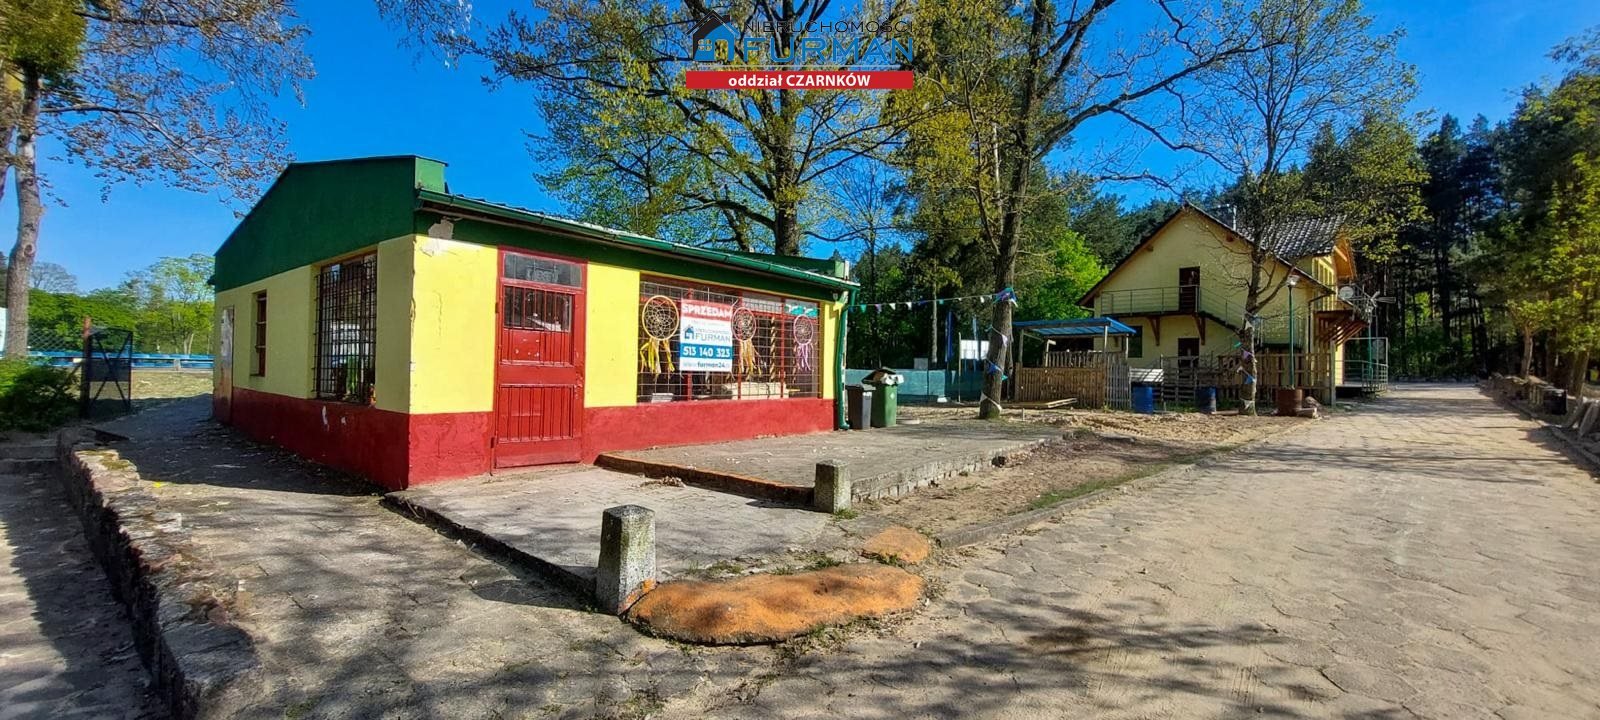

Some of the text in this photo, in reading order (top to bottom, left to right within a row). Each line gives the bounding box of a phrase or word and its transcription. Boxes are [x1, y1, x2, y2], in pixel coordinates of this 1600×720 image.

[682, 303, 732, 319] SPRZEDAM
[695, 332, 731, 343] FURMAN
[683, 346, 730, 358] 513 140 323
